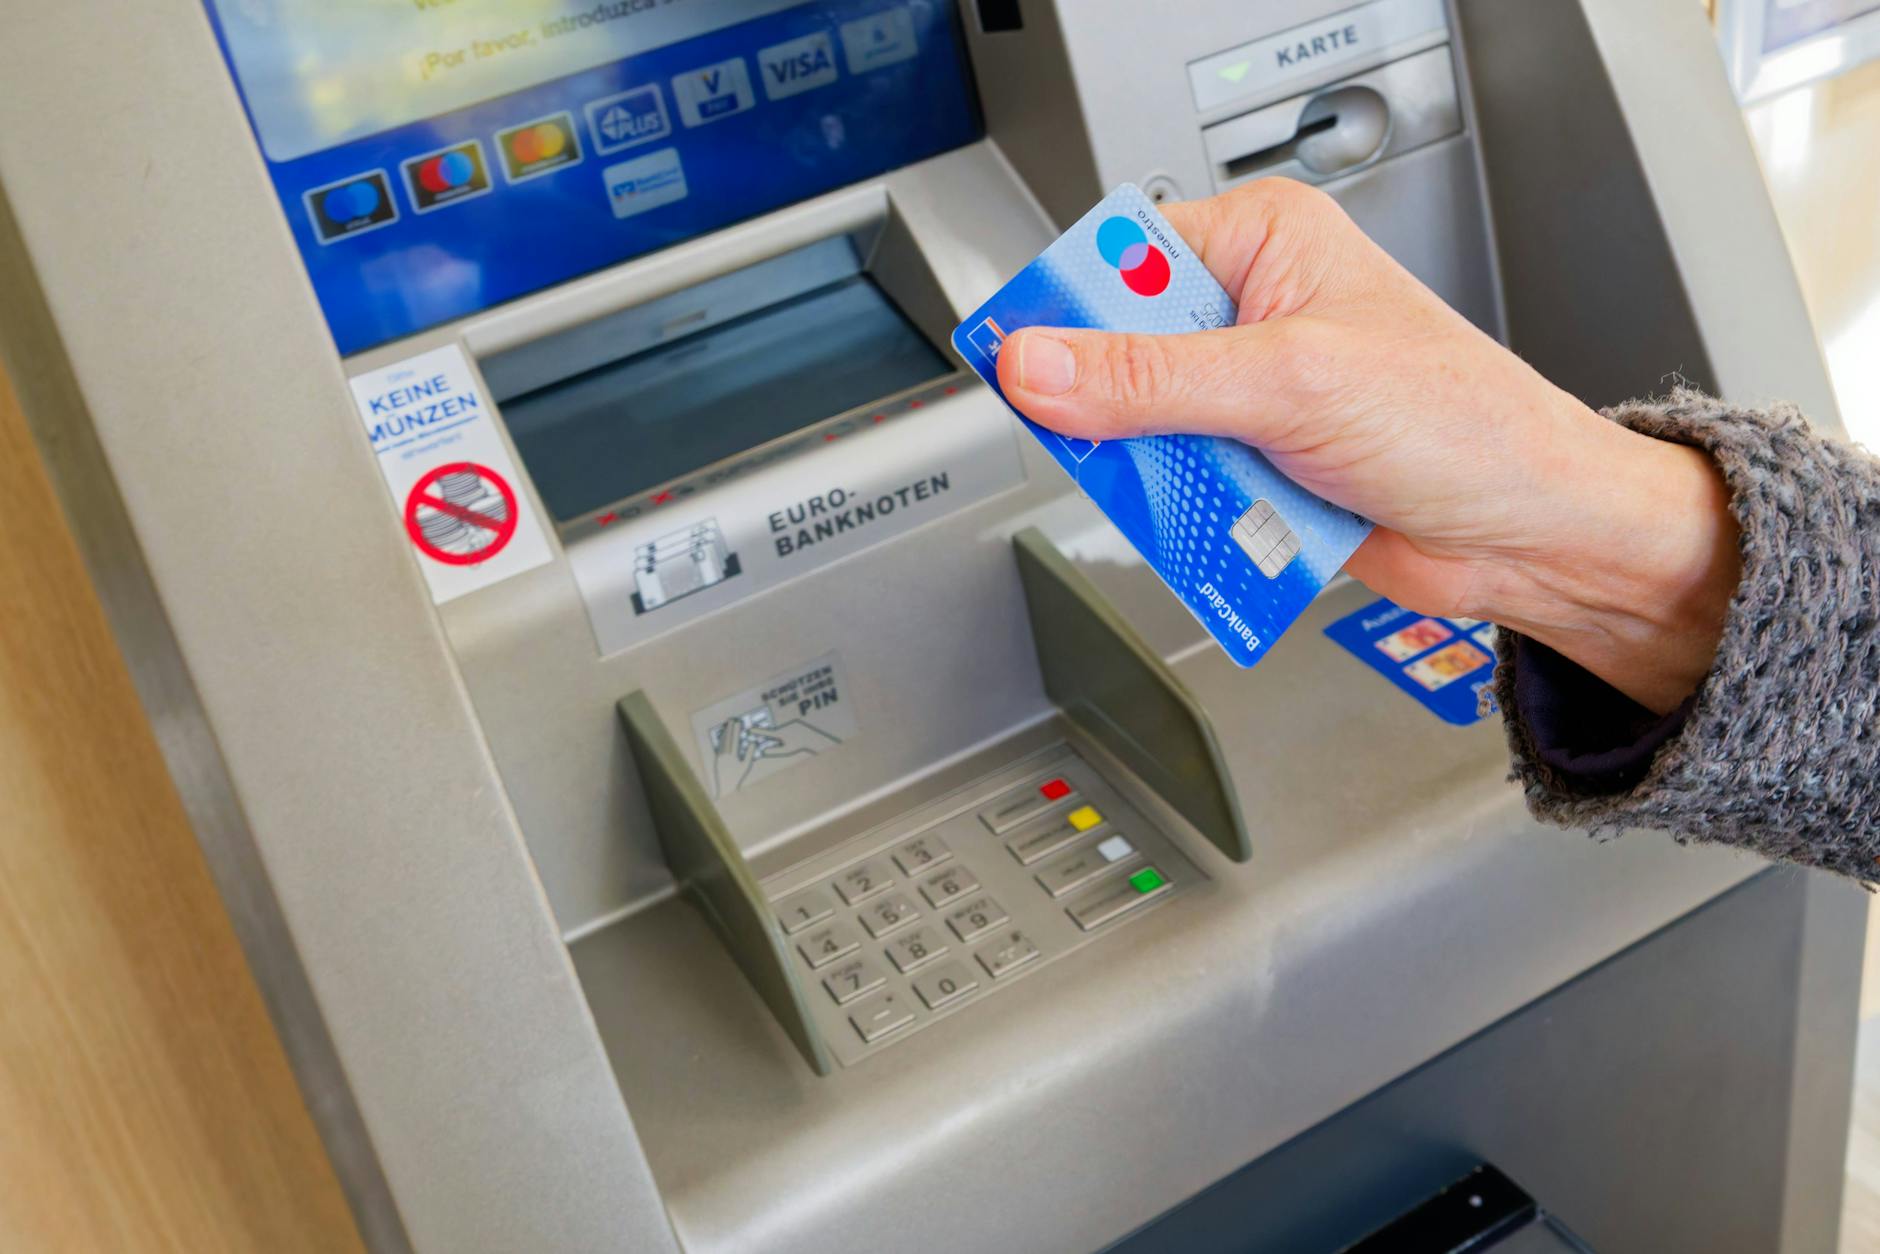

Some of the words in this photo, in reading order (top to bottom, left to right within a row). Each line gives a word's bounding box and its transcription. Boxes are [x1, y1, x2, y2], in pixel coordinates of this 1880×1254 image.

[1276, 25, 1359, 67] KARTE
[769, 47, 831, 84] VISA
[1138, 210, 1180, 259] maestro
[369, 374, 451, 414] KEINE
[768, 487, 856, 533] EURO-
[774, 471, 951, 558] BANKNOTEN
[1200, 582, 1261, 652] BankCard
[799, 687, 838, 716] PIN
[914, 850, 932, 864] 3
[856, 877, 871, 892] 2
[942, 881, 960, 894] 6
[797, 906, 811, 919] 1
[882, 910, 899, 925] 5
[970, 913, 988, 928] 9
[823, 939, 838, 954] 4
[909, 943, 927, 959] 8
[846, 973, 860, 989] 7
[938, 978, 956, 994] 0
